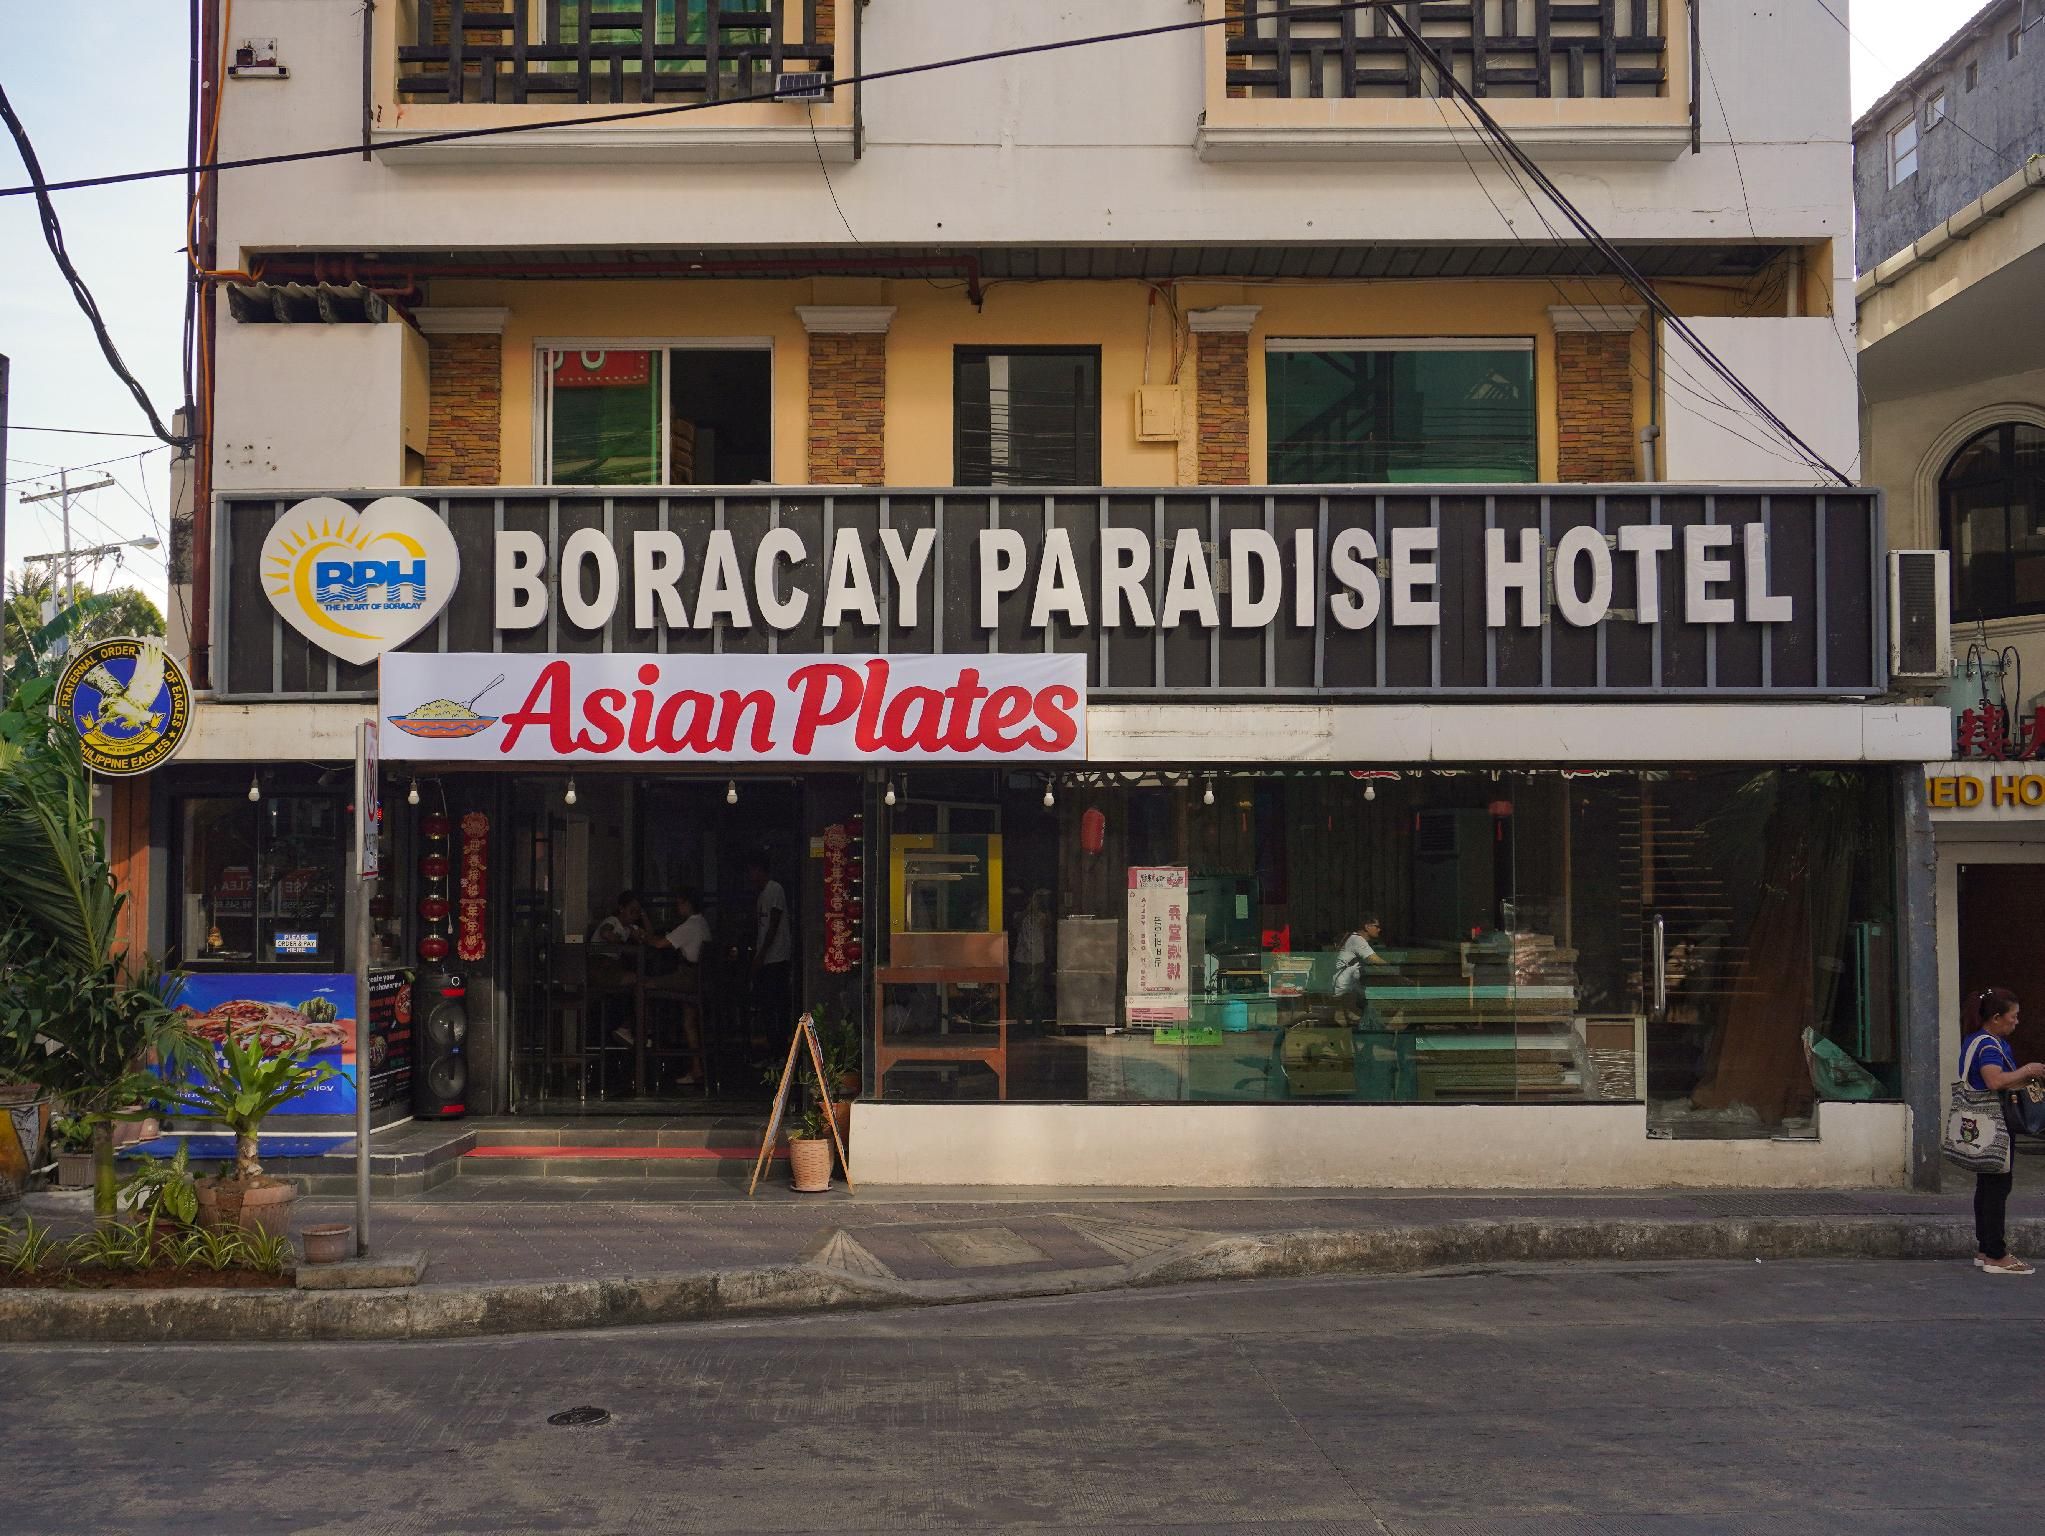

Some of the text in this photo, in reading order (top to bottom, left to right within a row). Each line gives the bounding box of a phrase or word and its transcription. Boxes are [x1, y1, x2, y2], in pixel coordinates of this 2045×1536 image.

[316, 559, 426, 602] BPH
[495, 522, 1793, 630] BORACAY PARADISE HOTEL
[342, 603, 369, 611] HEART
[383, 602, 422, 610] BORACAY
[61, 645, 136, 707] FRATERNAL ORDER
[164, 670, 185, 728] OF EAGLES
[499, 658, 1079, 756] Asian Plates
[79, 738, 171, 769] PHILIPPINE EAGLES
